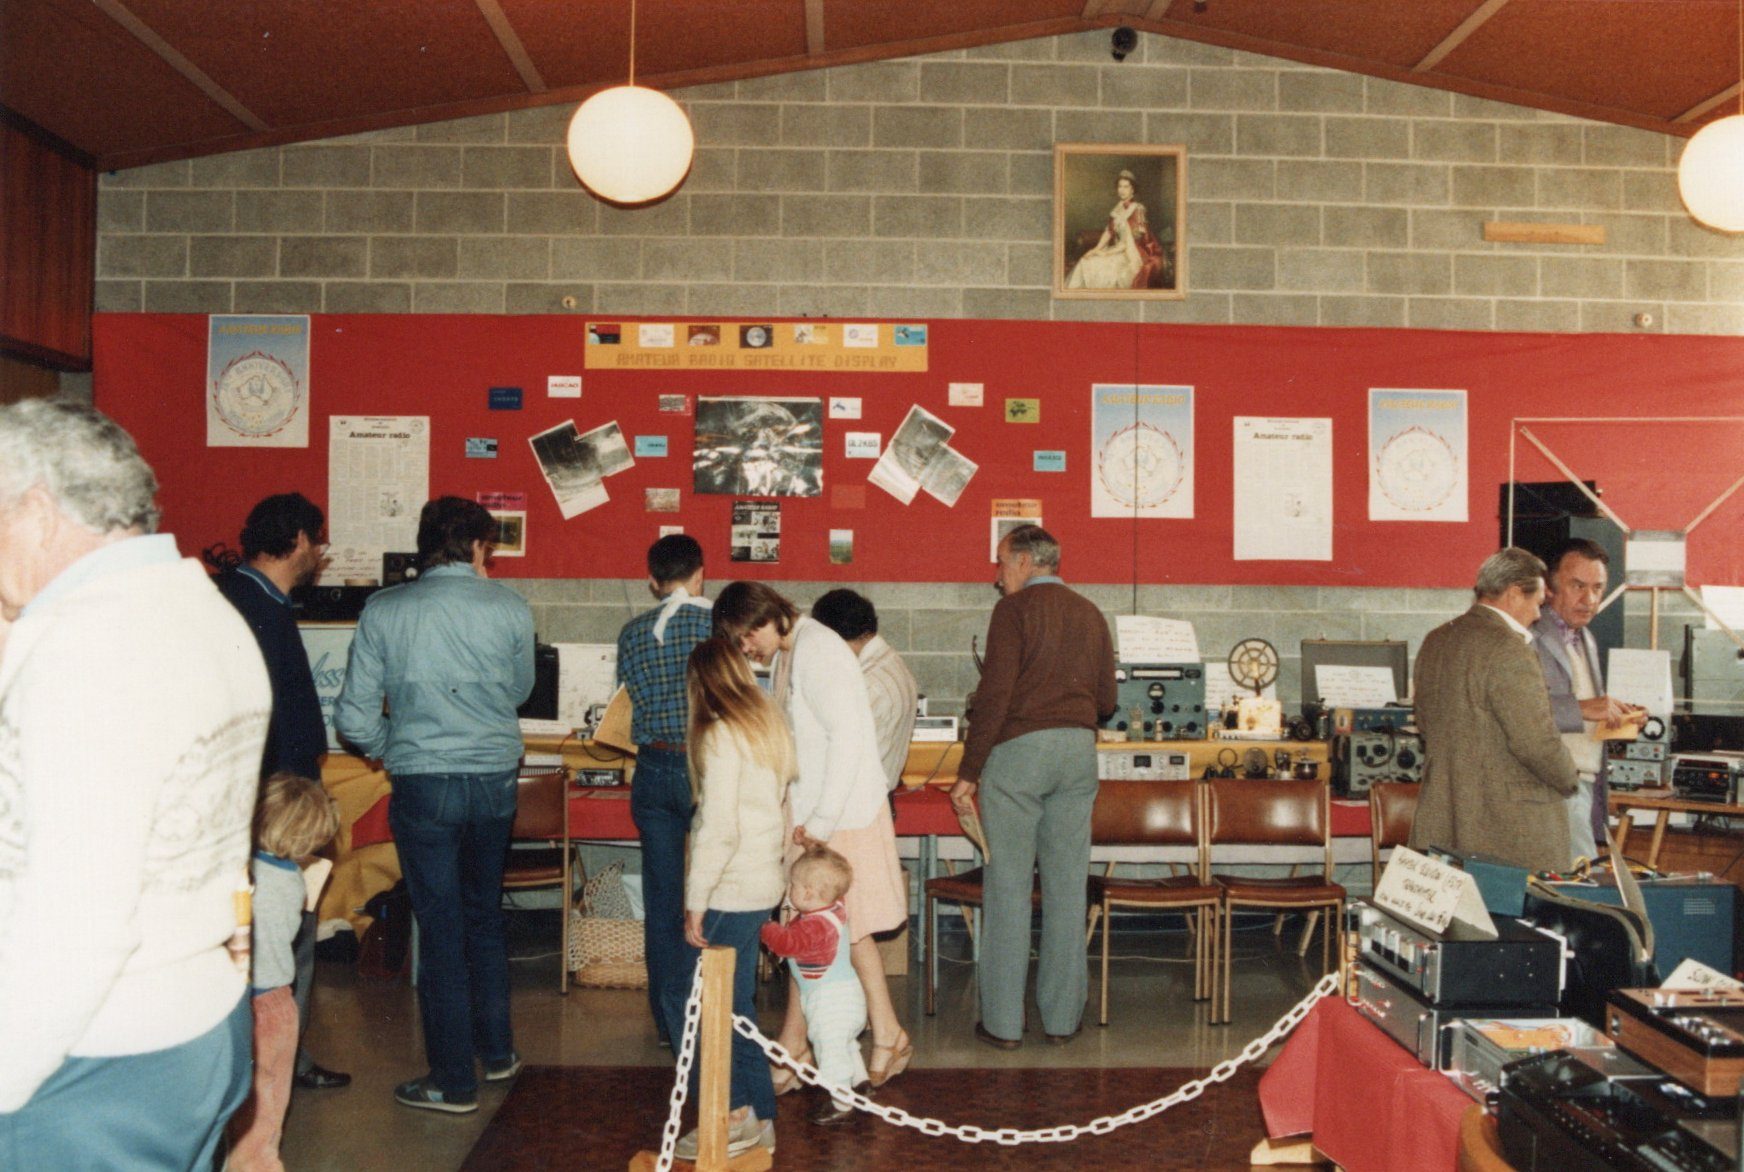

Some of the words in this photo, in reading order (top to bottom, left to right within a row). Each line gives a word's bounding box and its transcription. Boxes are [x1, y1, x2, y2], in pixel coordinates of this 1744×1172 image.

[616, 353, 680, 366] AMATEUR
[689, 354, 736, 366] RADIO
[744, 354, 826, 367] SATELLITE
[834, 355, 898, 368] DISPLAY
[349, 431, 386, 439] Amateur
[1253, 432, 1289, 440] Amateur
[1292, 433, 1313, 441] radio
